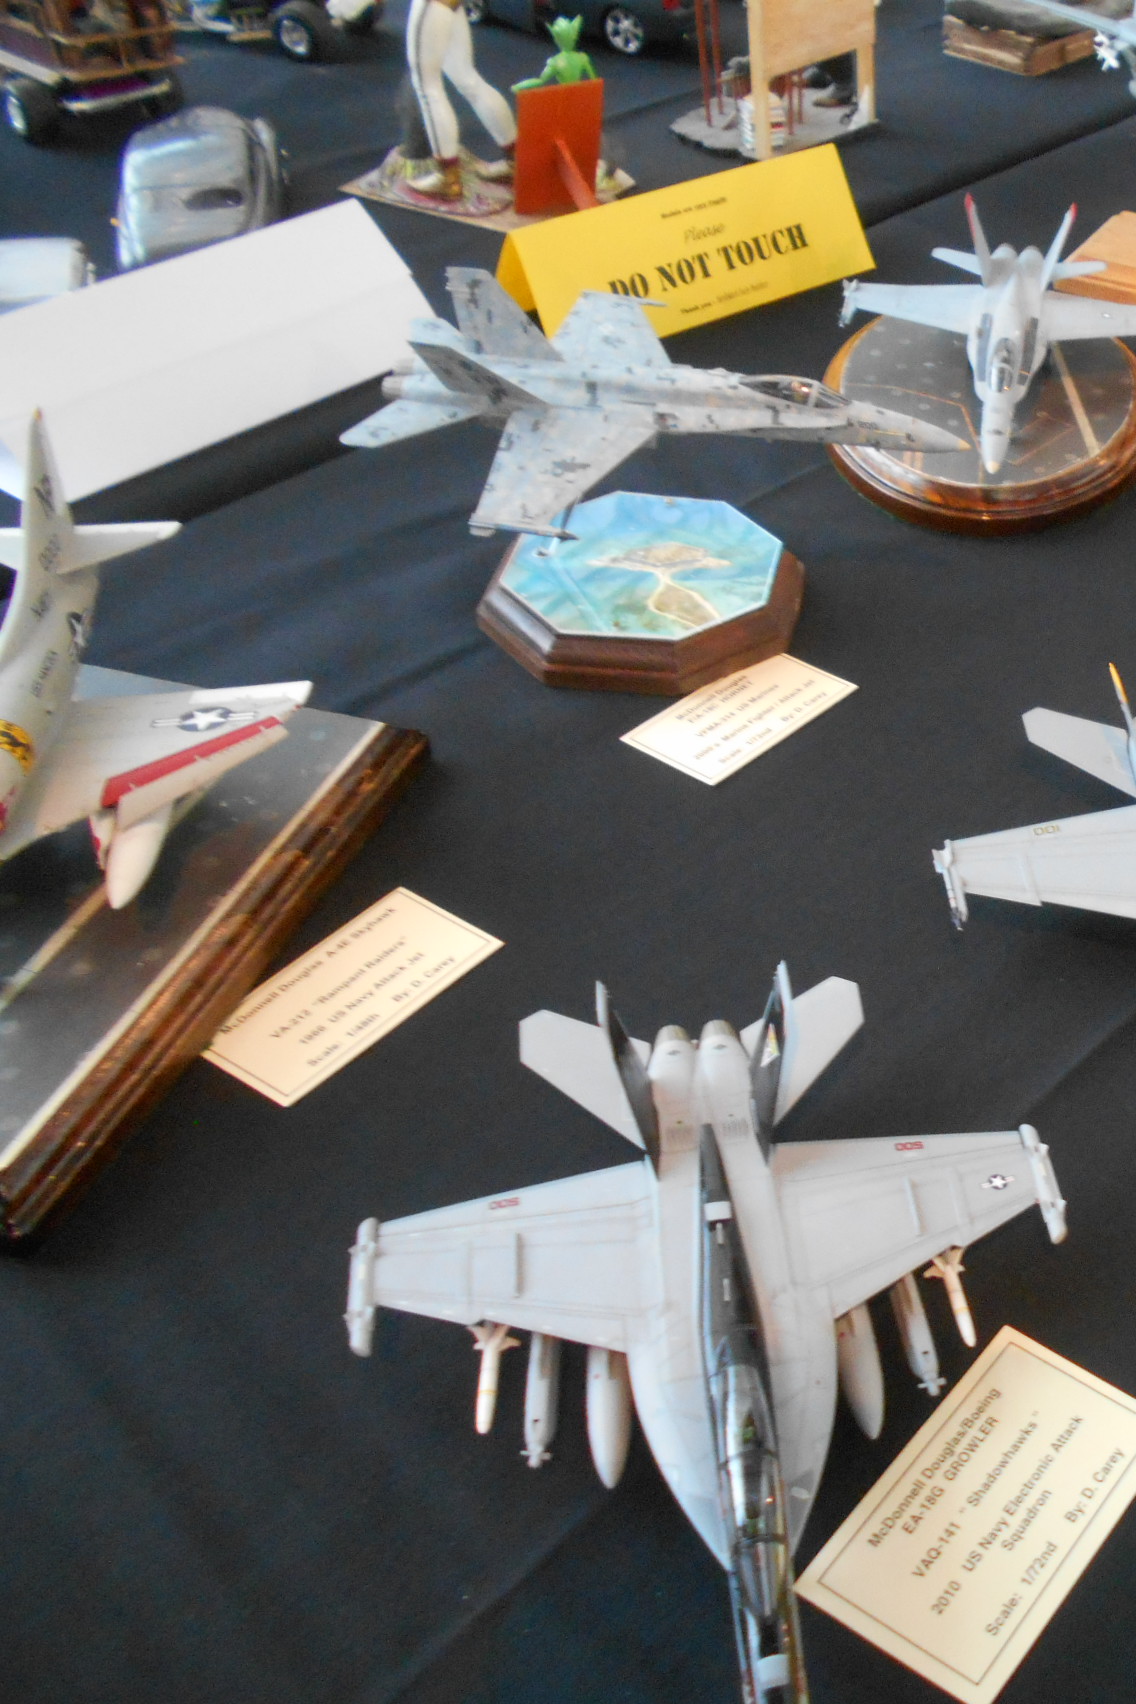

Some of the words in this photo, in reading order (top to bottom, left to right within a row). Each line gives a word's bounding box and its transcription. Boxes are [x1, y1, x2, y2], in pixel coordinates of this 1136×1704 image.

[655, 254, 711, 291] NOT
[716, 223, 809, 272] TOUCH
[868, 1477, 926, 1548] McDonnell
[923, 1387, 1001, 1480] Douglas/Boeing
[901, 1486, 945, 1535] EA-18G
[943, 1415, 1000, 1481] GROWLER
[911, 1521, 962, 1580] VAQ-141
[966, 1420, 1039, 1508] Shadowhawks
[931, 1581, 962, 1616] 2010
[961, 1550, 982, 1572] US
[978, 1518, 1010, 1553] Navy
[1006, 1454, 1055, 1517] Electronic
[1051, 1414, 1084, 1454] Attack
[984, 1593, 1023, 1637] Scale:
[1020, 1541, 1058, 1586] 1/72nd
[1064, 1498, 1086, 1524] By:
[1080, 1486, 1099, 1504] D.
[1092, 1447, 1126, 1484] Carey
[1000, 1489, 1053, 1552] Squadron
